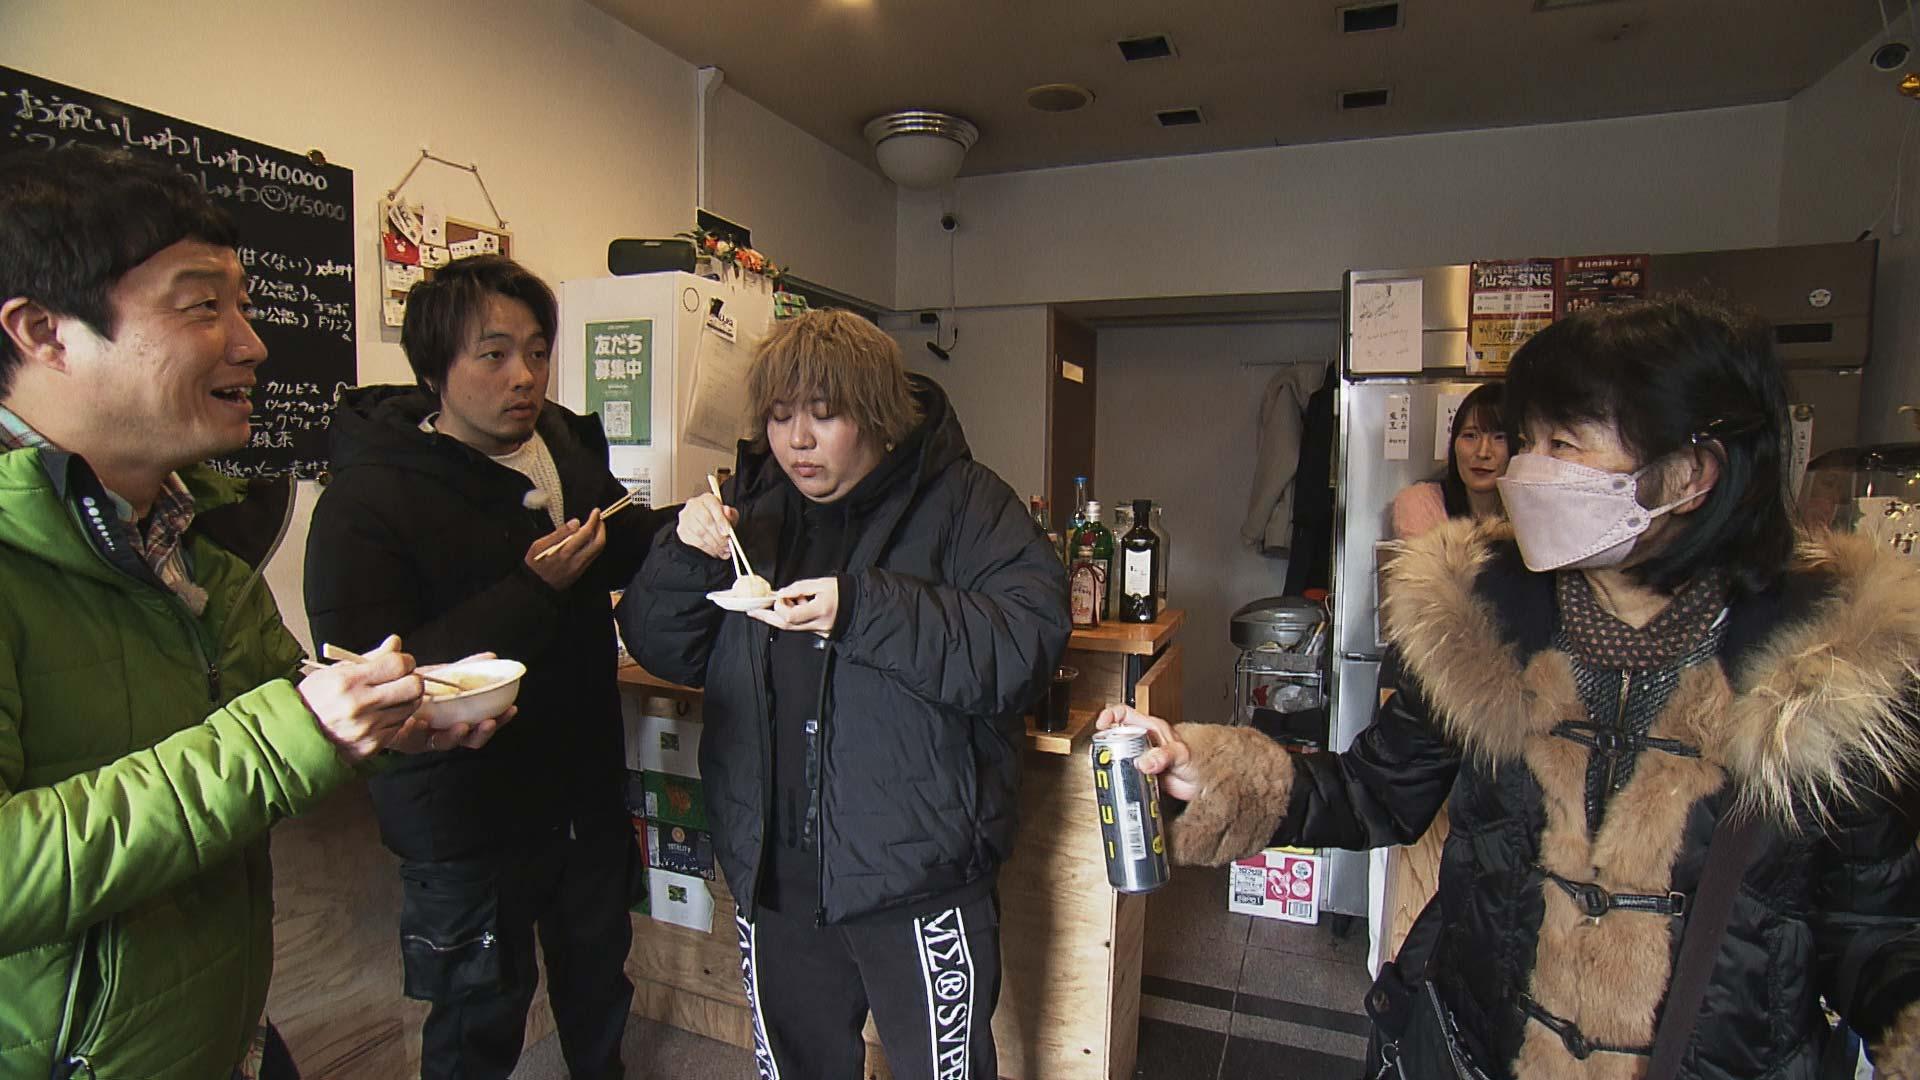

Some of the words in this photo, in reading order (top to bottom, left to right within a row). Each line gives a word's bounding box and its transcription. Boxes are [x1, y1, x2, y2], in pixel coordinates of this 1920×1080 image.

[1518, 272, 1553, 287] SNS
[594, 332, 643, 355] 友だち
[594, 358, 643, 381] 募集中
